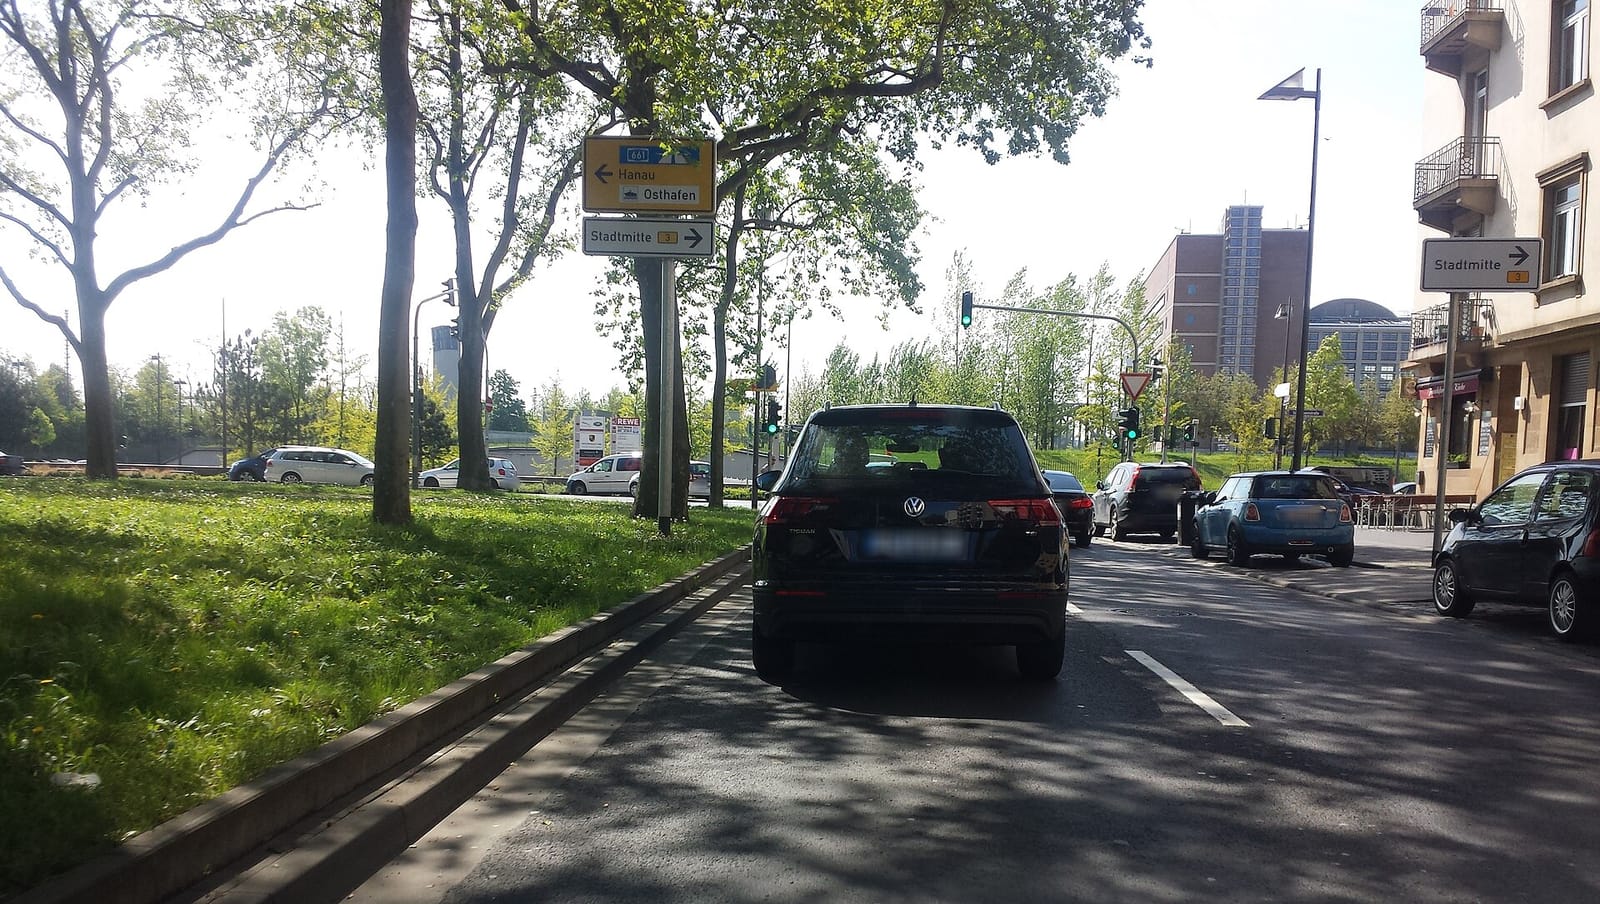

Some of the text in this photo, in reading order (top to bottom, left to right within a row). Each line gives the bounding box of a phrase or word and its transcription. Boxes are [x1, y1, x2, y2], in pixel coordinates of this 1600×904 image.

[631, 150, 646, 159] 661
[618, 169, 655, 180] Hanau
[644, 188, 696, 201] Osthafen
[591, 231, 671, 242] Stadtmitte 3
[1434, 259, 1501, 270] Stadtmitte
[1514, 273, 1521, 281] 3
